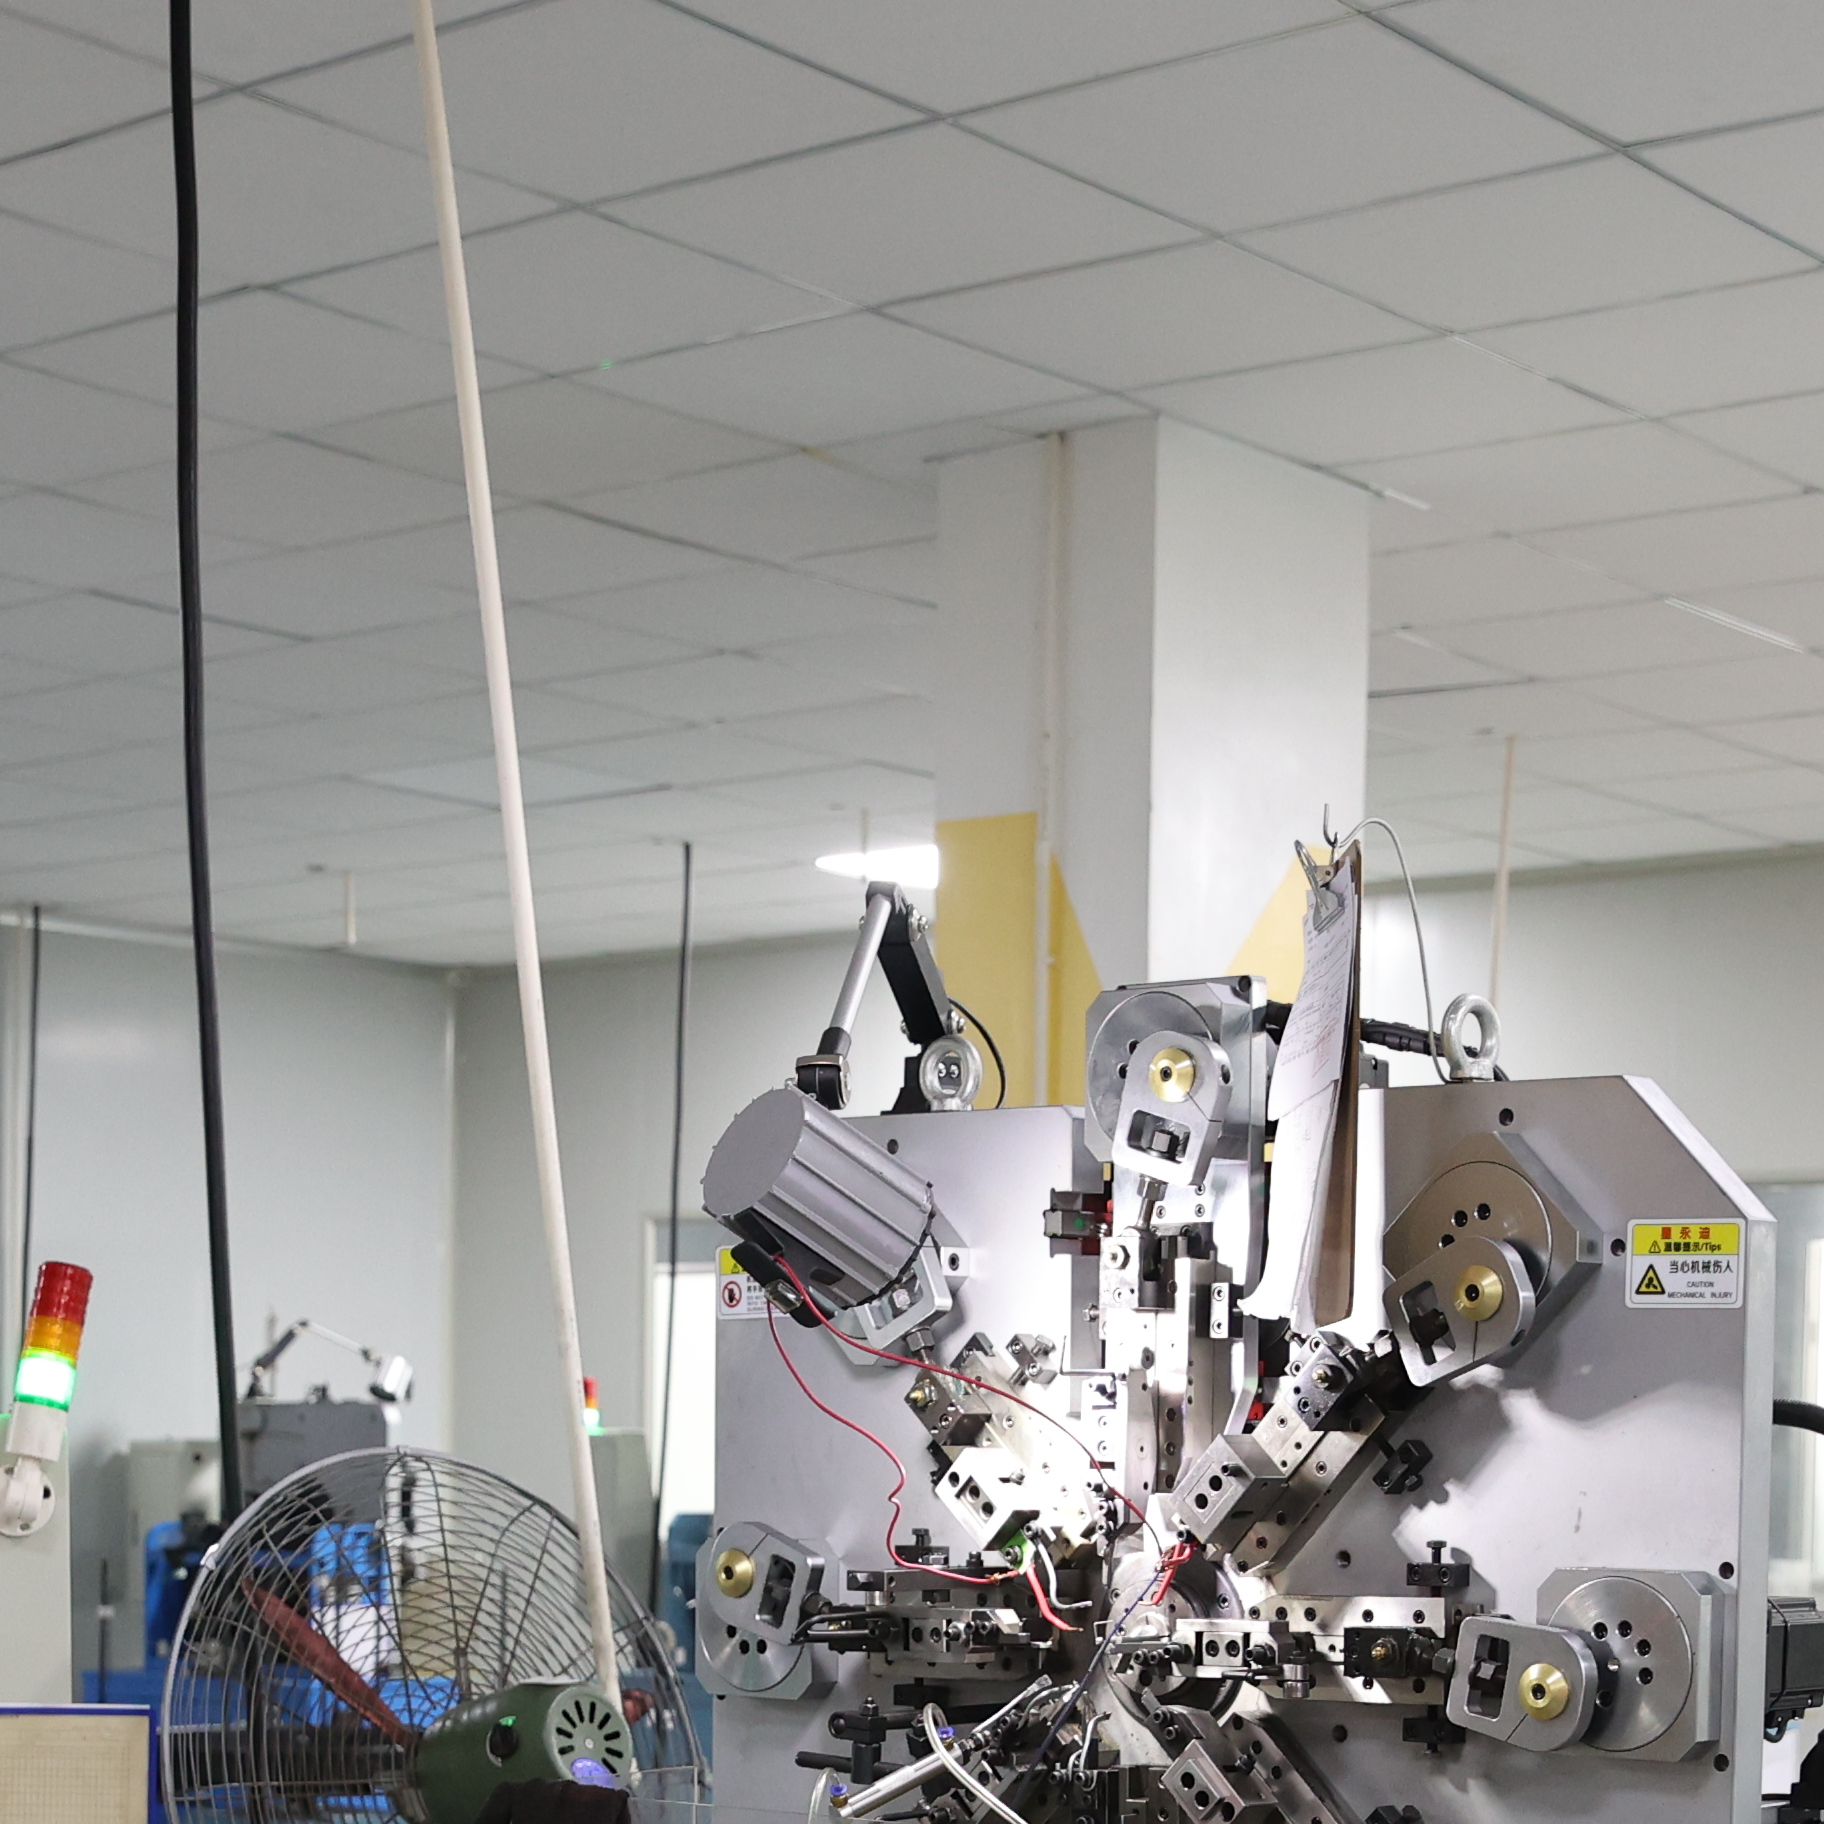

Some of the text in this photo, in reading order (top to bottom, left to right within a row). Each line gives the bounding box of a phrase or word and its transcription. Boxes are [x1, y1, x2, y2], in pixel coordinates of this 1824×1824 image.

[1669, 1260, 1733, 1274] 当心机械伤人
